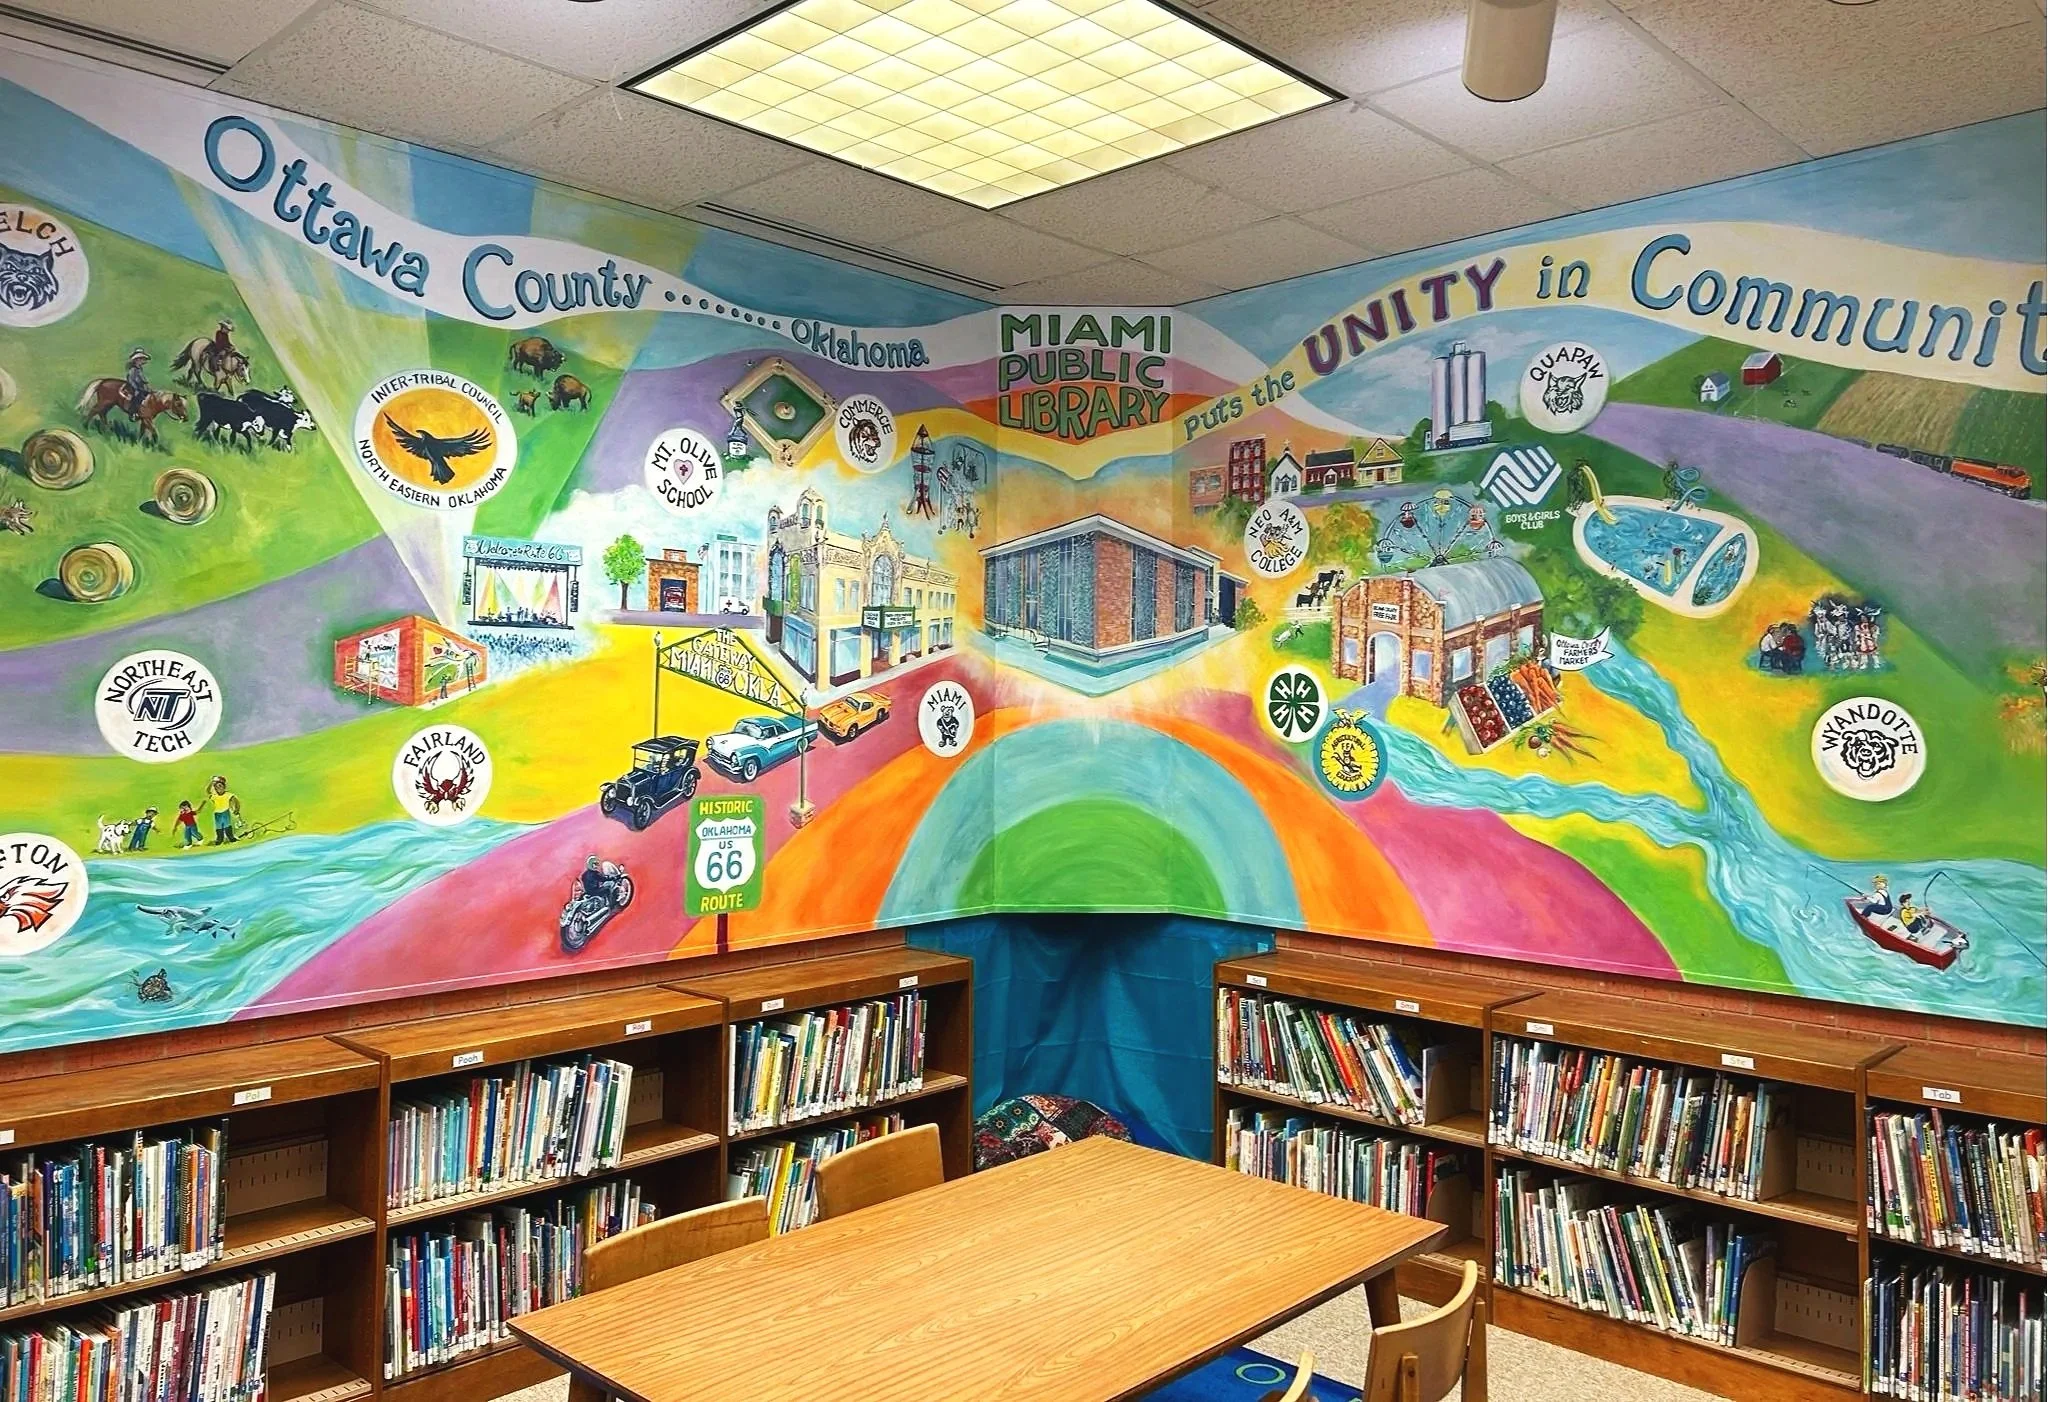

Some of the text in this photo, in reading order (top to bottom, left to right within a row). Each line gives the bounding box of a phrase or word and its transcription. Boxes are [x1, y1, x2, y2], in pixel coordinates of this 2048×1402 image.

[204, 115, 930, 369] Ottawa County Oklahoma
[1000, 313, 1172, 354] MIAMI
[1251, 370, 1296, 407] the
[1302, 257, 1506, 377] UNITY
[1537, 256, 1592, 299] in
[999, 349, 1167, 391] PUBLIC
[1529, 346, 1604, 382] QUAPAW
[370, 373, 505, 425] INTER-TRIBAL COUNCIL
[1000, 386, 1171, 440] LIBRARY
[839, 399, 894, 435] COMMERCE
[359, 439, 508, 509] NORTH EASTERN OKLAHOMA
[651, 437, 718, 481] MT. OLIVE
[657, 478, 714, 509] SCHOOL
[1248, 508, 1304, 539] NEO A&M
[1505, 513, 1527, 524] BOYS
[1534, 510, 1561, 521] GIRLS
[1520, 520, 1545, 530] CLUB
[1250, 546, 1303, 573] COLLEGE
[715, 628, 737, 644] THE
[692, 637, 757, 671] GATEWAY
[1559, 656, 1589, 665] MARKET
[104, 659, 213, 703] NORTHEAST
[133, 688, 190, 722] NT
[926, 687, 967, 712] MIAMI
[132, 730, 192, 752] TECH
[1822, 703, 1918, 756] WYANDOTTE
[403, 731, 486, 768] FAIRLAND
[700, 800, 753, 817] HISTORIC
[701, 823, 752, 838] OKLAHOMA
[718, 840, 733, 850] US
[706, 850, 743, 883] 66
[700, 892, 744, 912] ROUTE
[458, 1054, 478, 1065] Pooh
[1930, 1089, 1952, 1100] Tab
